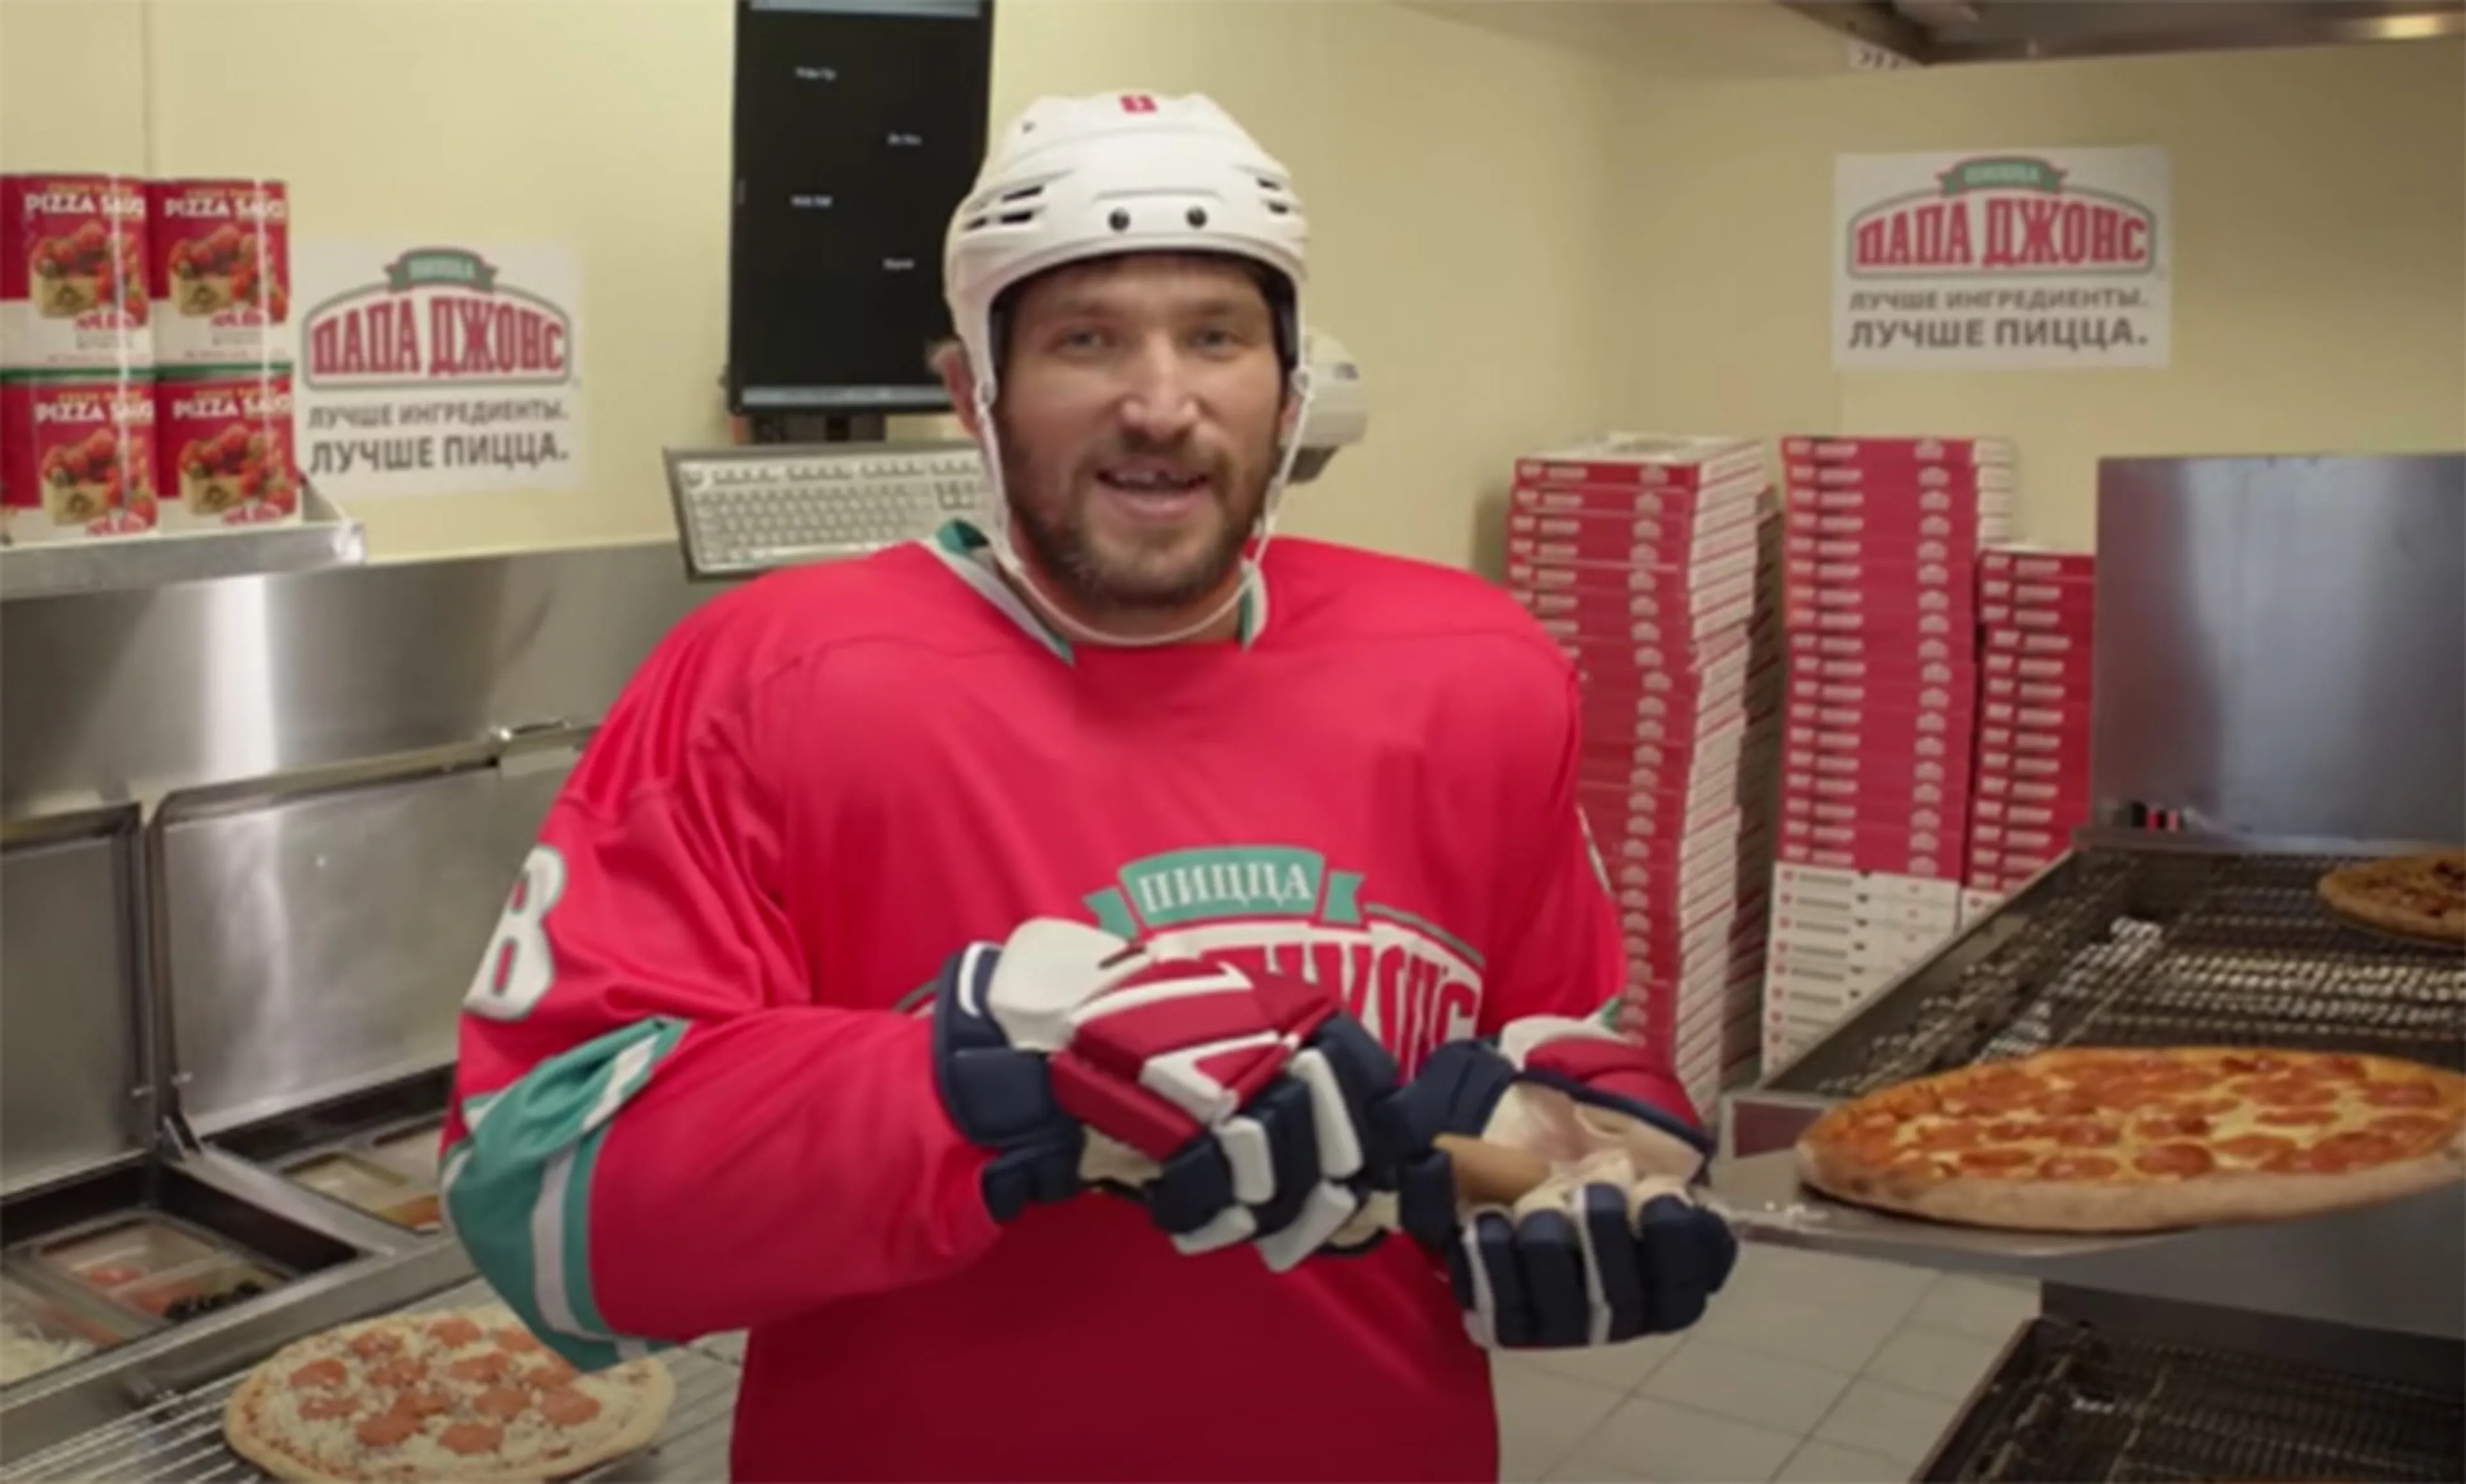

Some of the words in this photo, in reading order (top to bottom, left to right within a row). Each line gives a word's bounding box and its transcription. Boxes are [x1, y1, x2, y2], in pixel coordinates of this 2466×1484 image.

[25, 193, 94, 214] PIZZA
[164, 198, 229, 217] PIZZA
[1855, 200, 1972, 266] ПАПА
[1982, 198, 2147, 269] ДЖОНС
[1849, 290, 1937, 311] ЛУЧШЕ
[1945, 287, 2149, 311] ИНГРЕДИЕНТЫ.
[311, 298, 421, 376] ПАПА
[428, 295, 564, 377] ДЖОНС
[1848, 319, 1985, 349] ЛУЧШЕ
[1994, 317, 2149, 352] ПИЦЦА.
[34, 402, 104, 423] PIZZA
[173, 398, 239, 419] PIZZA
[308, 403, 393, 429] ЛУЧШЕ
[310, 437, 435, 475] ЛУЧШЕ
[442, 432, 569, 469] ПИЦЦА.
[1137, 860, 1313, 913] ПИЦЦА
[461, 843, 564, 1021] 8
